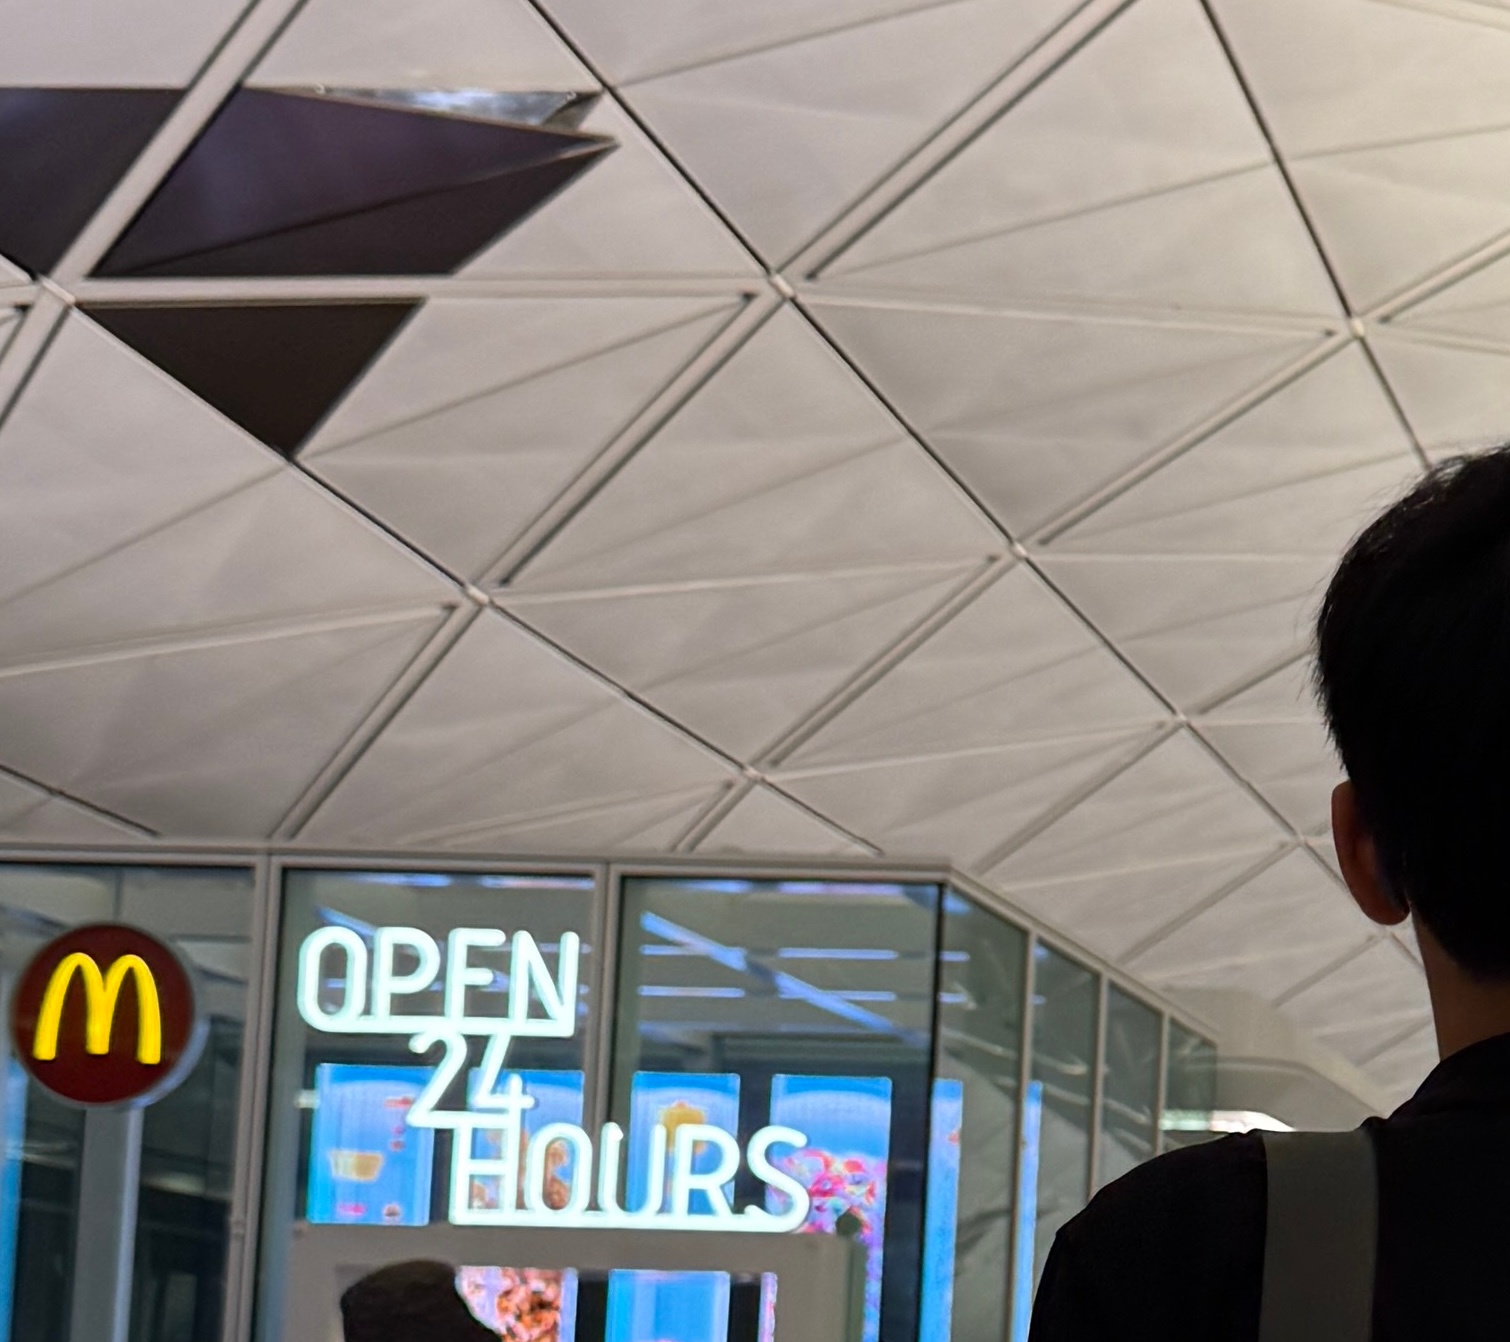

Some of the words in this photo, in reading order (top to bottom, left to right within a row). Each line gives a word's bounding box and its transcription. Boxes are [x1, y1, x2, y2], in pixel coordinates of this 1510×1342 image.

[297, 926, 580, 1037] OPEN
[407, 1032, 535, 1128] 24
[449, 1122, 810, 1233] HOURS
